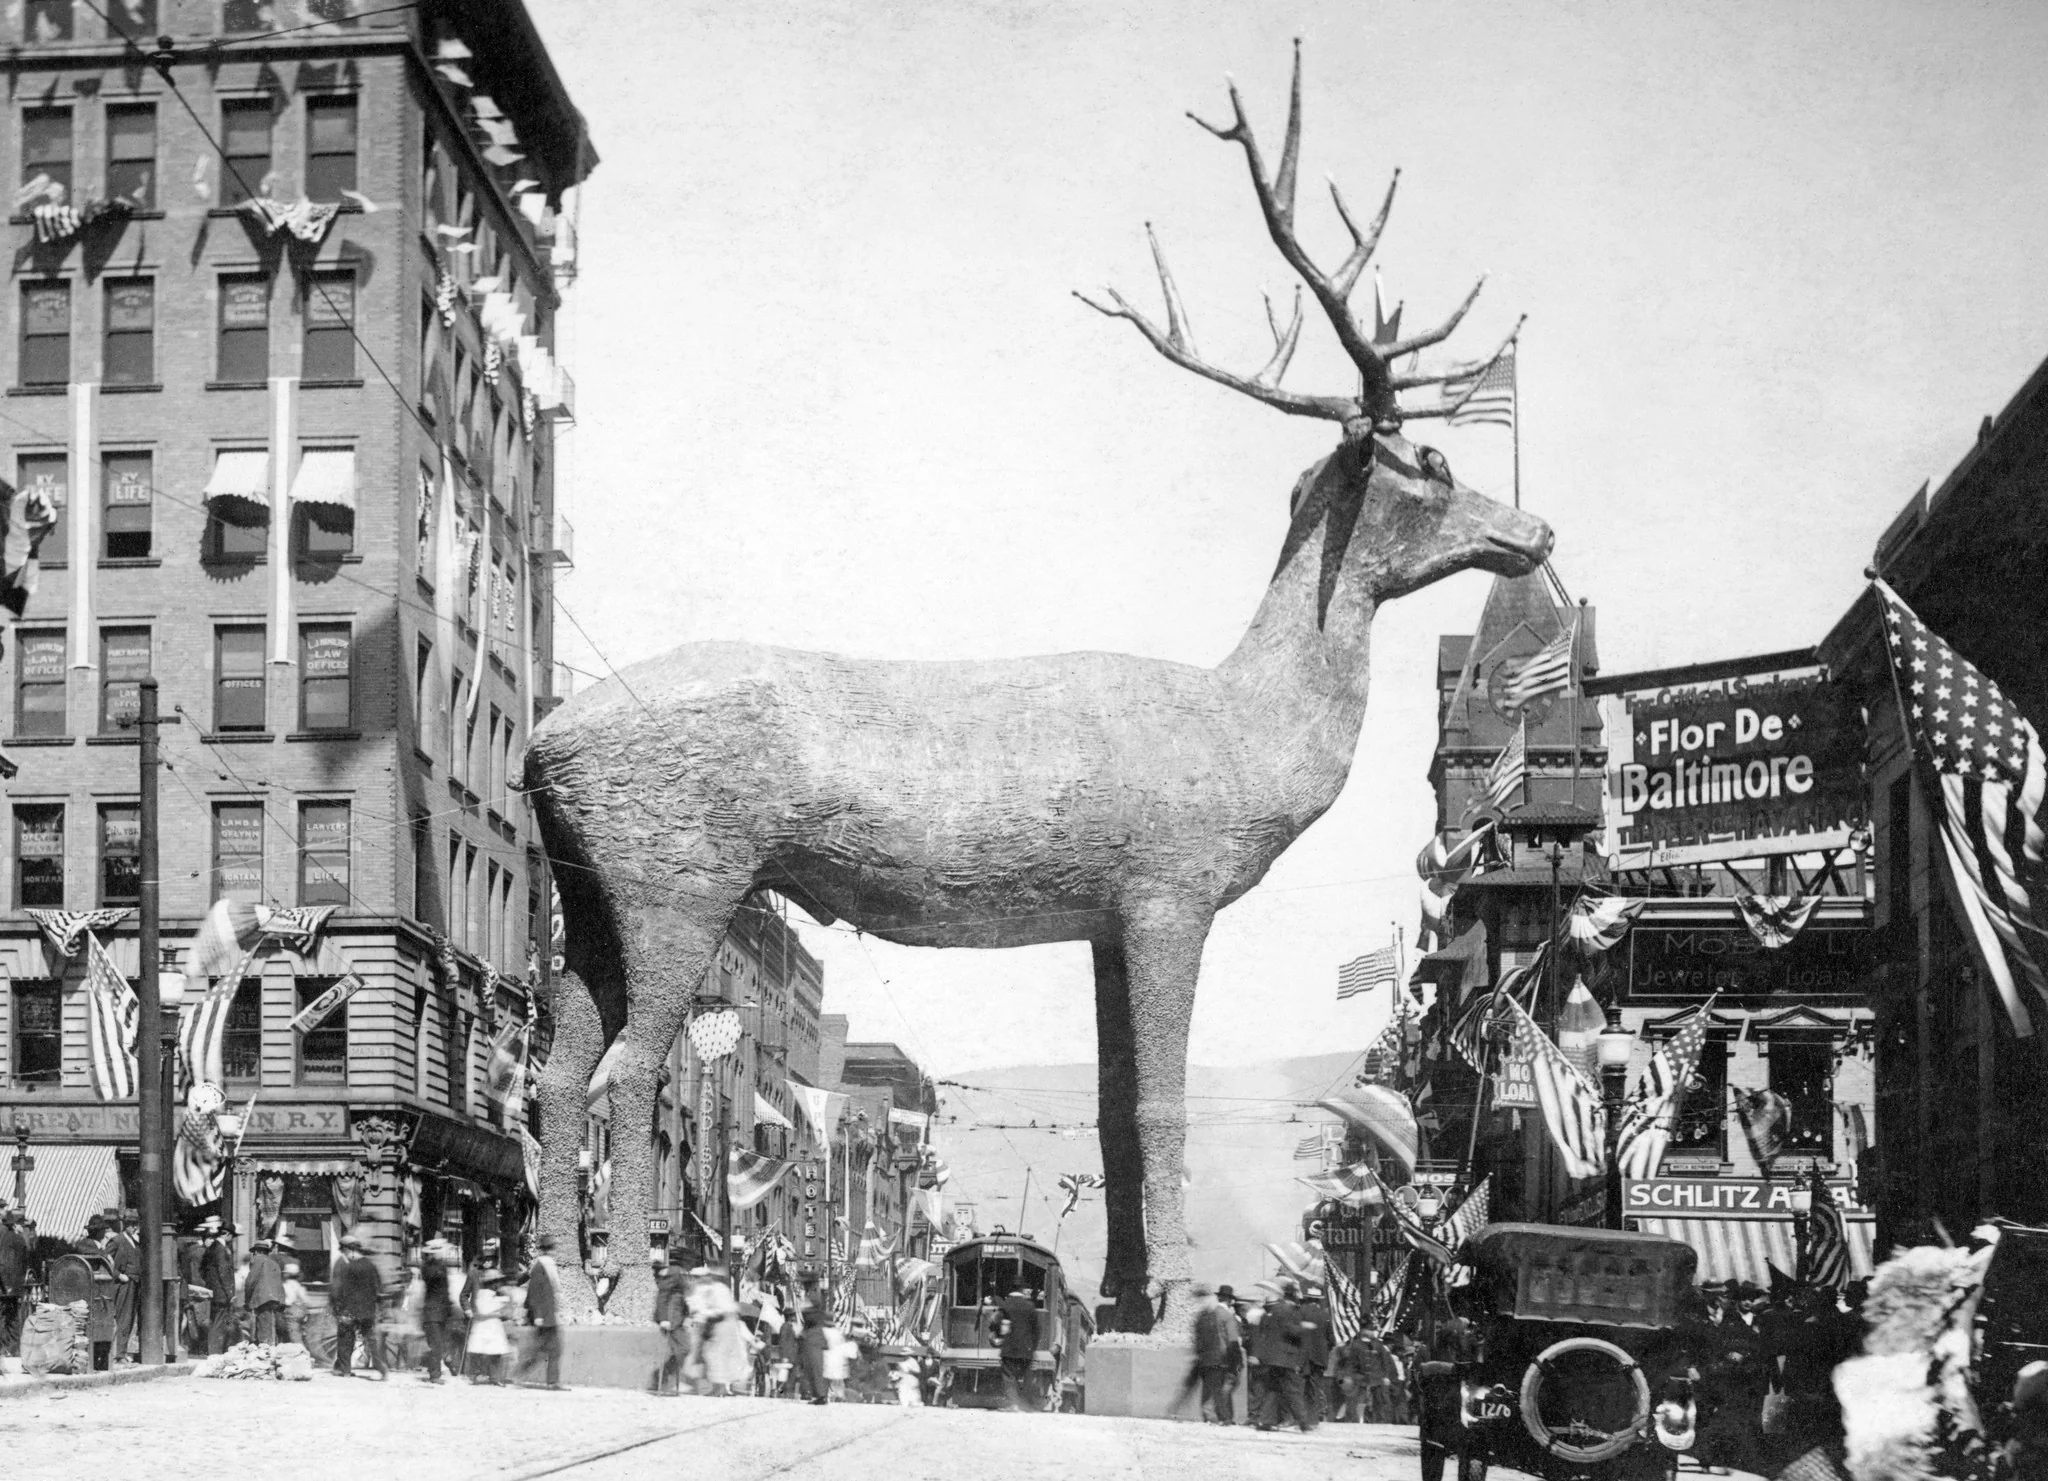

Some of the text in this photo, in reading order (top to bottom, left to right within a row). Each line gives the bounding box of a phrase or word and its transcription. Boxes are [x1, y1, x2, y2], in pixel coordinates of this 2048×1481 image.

[115, 484, 146, 500] LIFE
[315, 650, 341, 658] LAW
[31, 656, 58, 664] LAW
[307, 661, 349, 669] OFFICES
[24, 666, 65, 675] OFFICES
[225, 680, 261, 688] OFFICES
[1650, 708, 1784, 756] Flor De
[1621, 754, 1815, 815] Baltimore
[314, 872, 341, 881] LIFE
[351, 1048, 391, 1056] MAIN ST
[9, 1112, 102, 1130] GREAT
[287, 1112, 339, 1128] R.Y.
[1629, 1184, 1762, 1209] SCHLITZ
[804, 1165, 818, 1256] HOTEL
[648, 1220, 667, 1229] EED
